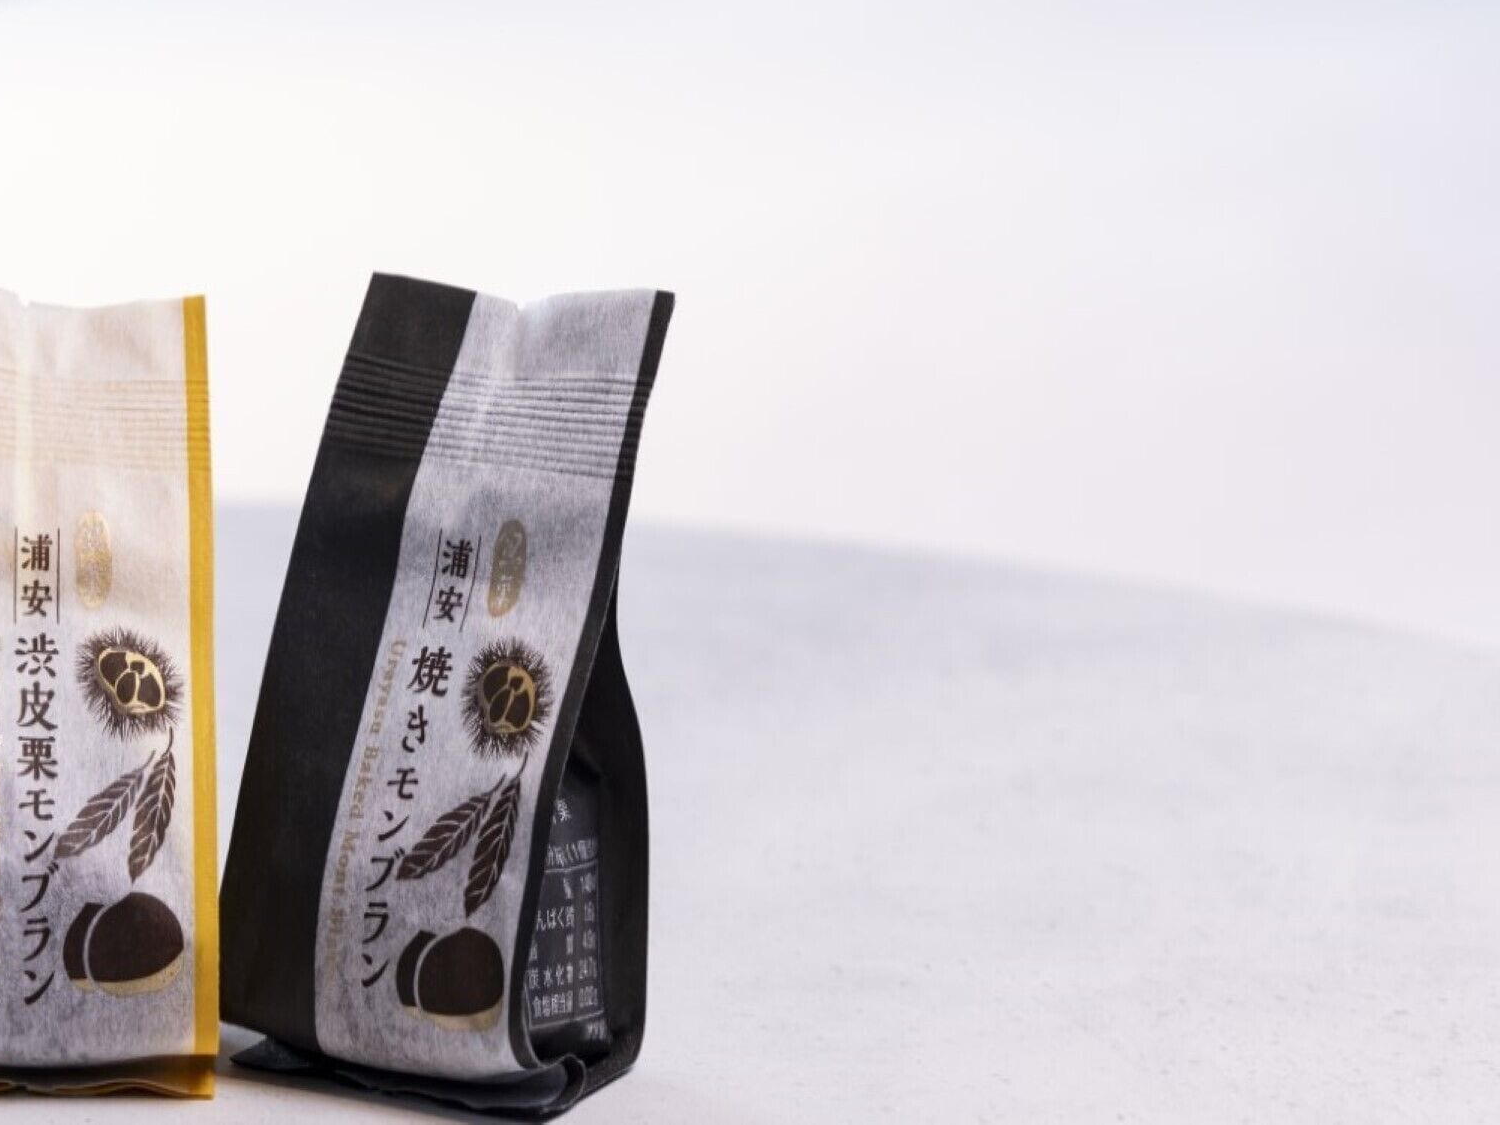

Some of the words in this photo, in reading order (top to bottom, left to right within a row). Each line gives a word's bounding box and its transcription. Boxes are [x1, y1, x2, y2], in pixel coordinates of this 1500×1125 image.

[21, 533, 53, 617] 浦安
[432, 539, 474, 623] 浦安
[15, 632, 60, 1006] 渋皮栗モンブラン
[348, 745, 380, 819] Baked
[362, 645, 453, 988] 焼きモンブラン
